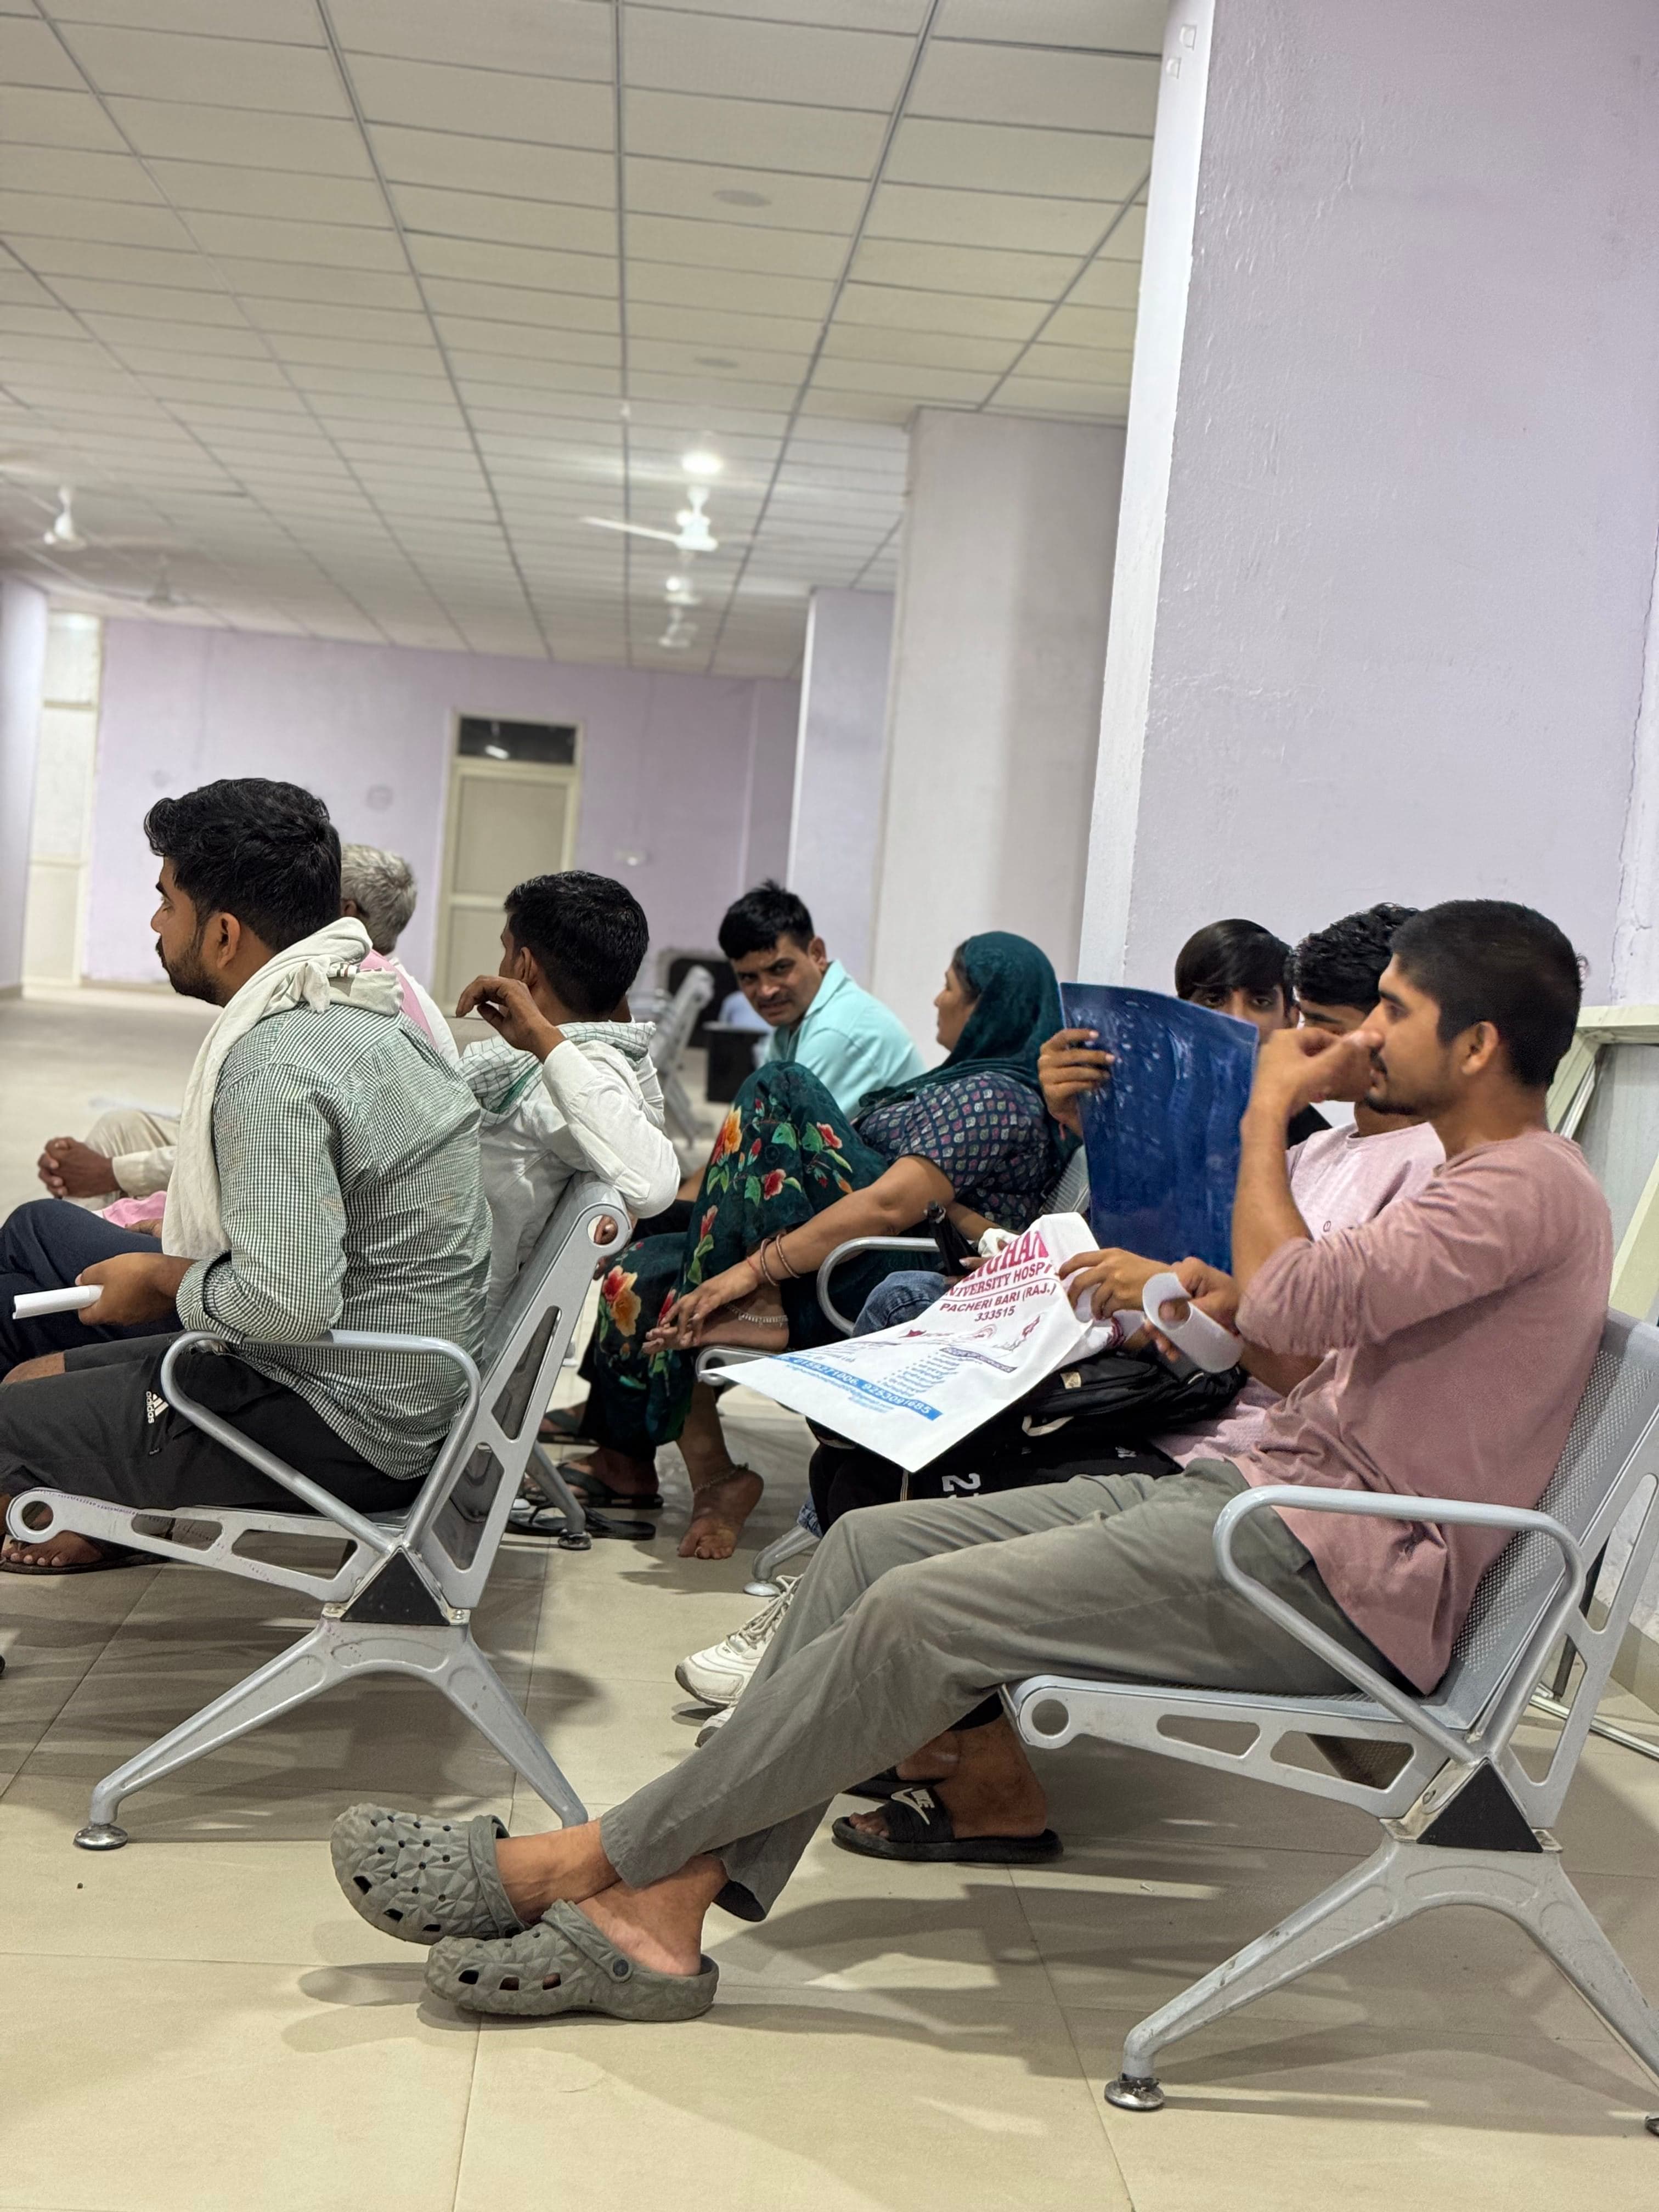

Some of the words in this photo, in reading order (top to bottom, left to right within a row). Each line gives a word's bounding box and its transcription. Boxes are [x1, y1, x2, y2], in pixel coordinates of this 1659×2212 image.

[940, 1299, 992, 1312] PACHERI
[995, 1290, 1020, 1306] BARI
[1023, 1283, 1057, 1302] (RAJ.)
[975, 1306, 1016, 1322] 333515
[146, 1391, 154, 1424] adidas
[942, 1473, 981, 1498] 2
